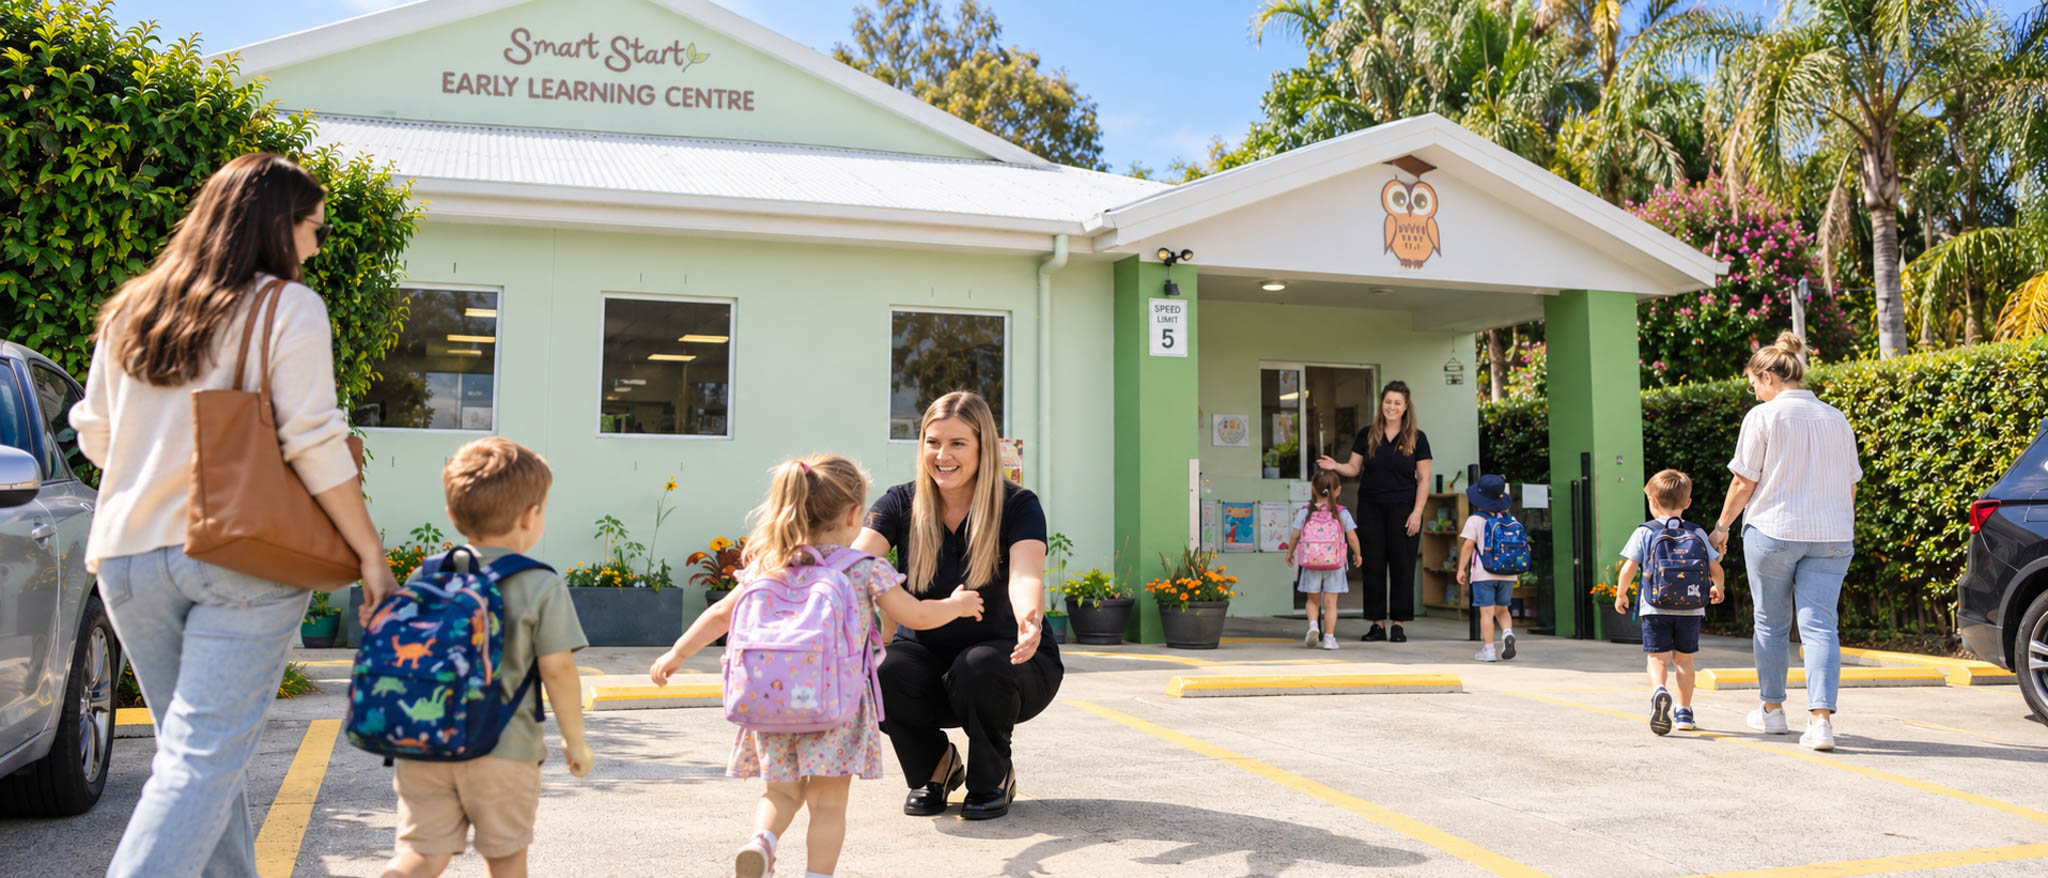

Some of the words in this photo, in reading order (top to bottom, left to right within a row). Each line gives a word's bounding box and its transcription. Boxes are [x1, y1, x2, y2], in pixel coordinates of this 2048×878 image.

[504, 27, 599, 65] Smart
[604, 35, 684, 72] Start
[442, 71, 519, 97] EARLY
[528, 77, 656, 106] LEARNING
[664, 86, 755, 111] CENTRE
[1154, 304, 1181, 314] SPEED
[1156, 315, 1178, 324] LIMIT
[1161, 328, 1175, 349] 5
